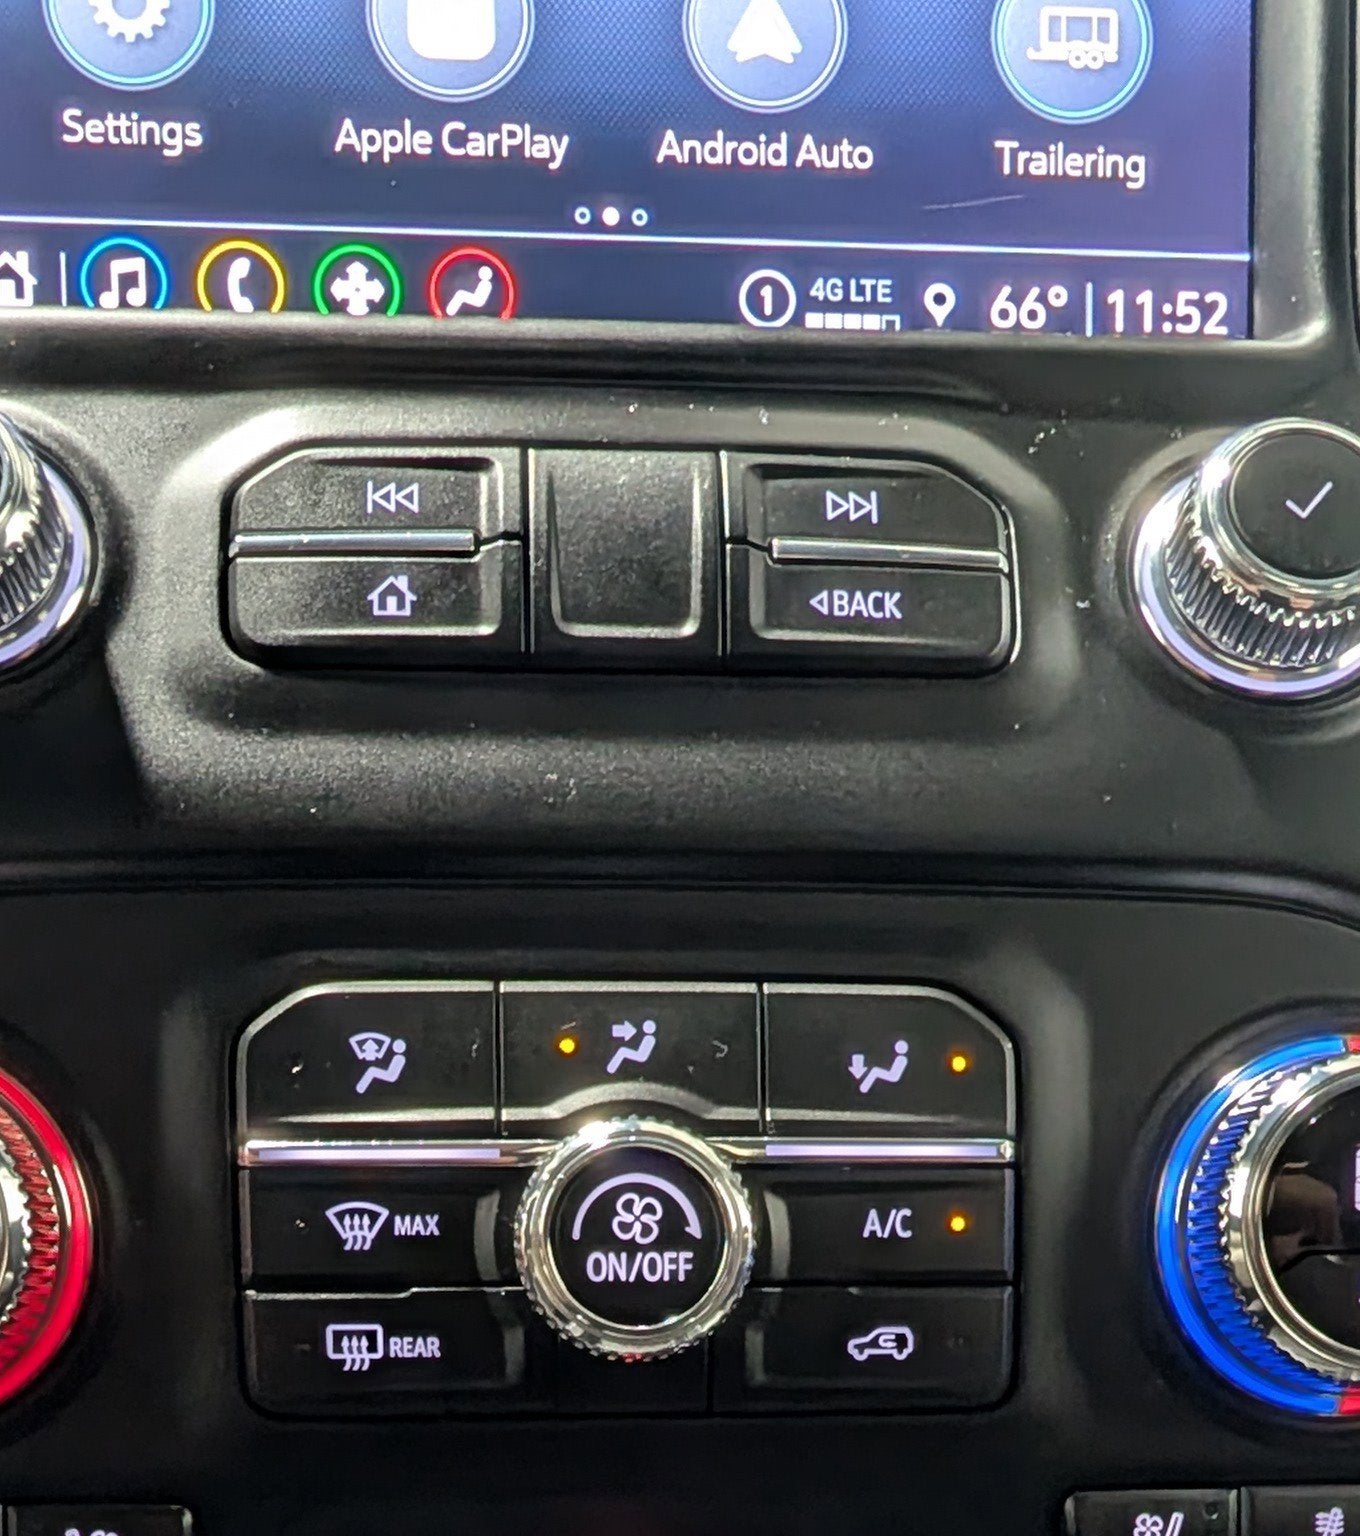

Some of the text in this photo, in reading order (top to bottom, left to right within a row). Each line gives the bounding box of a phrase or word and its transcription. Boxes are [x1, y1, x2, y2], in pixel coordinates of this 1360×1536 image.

[62, 107, 203, 157] Settings
[334, 117, 570, 170] Apple CarPlay
[656, 128, 874, 170] Android Auto
[994, 140, 1146, 190] Trailering
[809, 277, 893, 303] 4G LTE
[990, 284, 1069, 330] 66°
[1107, 288, 1229, 336] 11:52
[832, 589, 902, 619] BACK
[394, 1214, 440, 1236] MAX
[862, 1208, 913, 1239] A/C
[586, 1251, 694, 1283] ON/OFF
[389, 1336, 442, 1358] REAR
